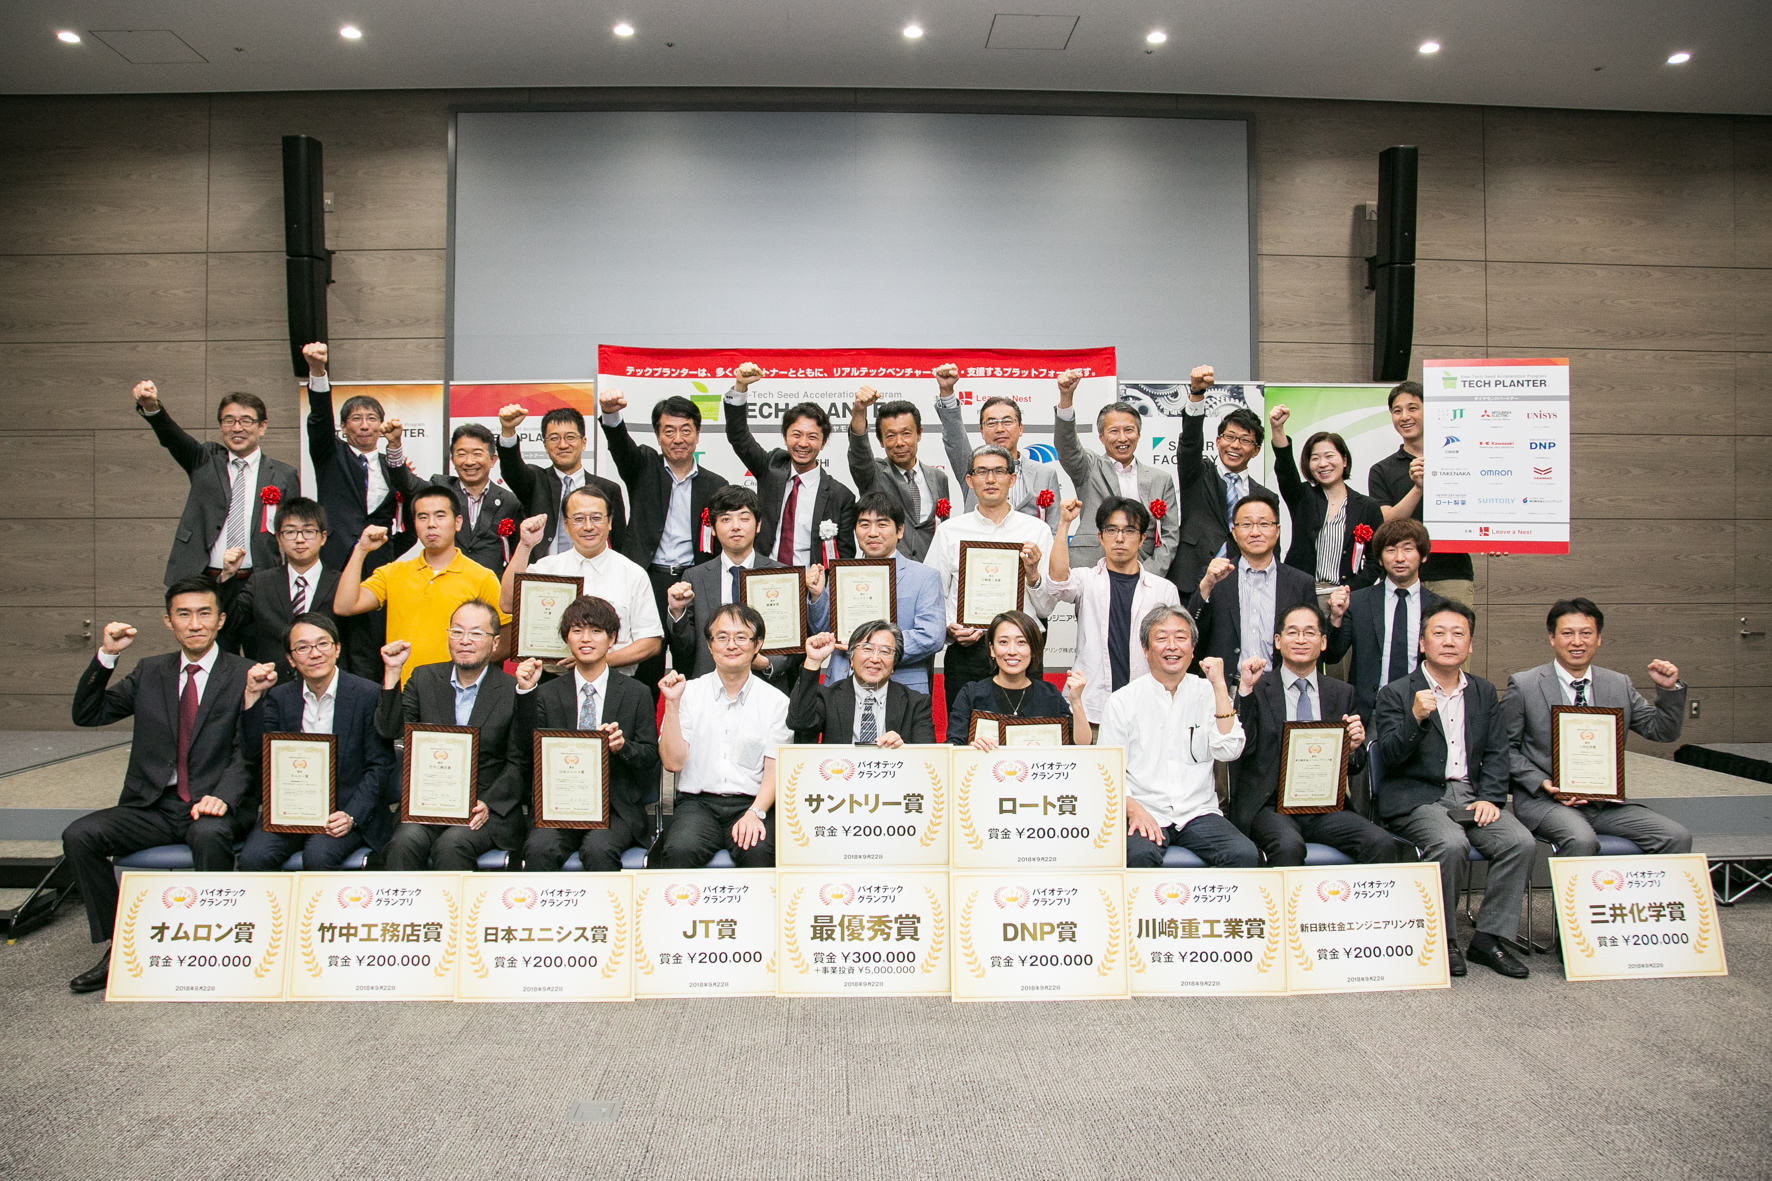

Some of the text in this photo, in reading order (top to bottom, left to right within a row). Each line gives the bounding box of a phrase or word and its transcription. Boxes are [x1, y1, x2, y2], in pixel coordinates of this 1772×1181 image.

[881, 392, 902, 400] gram
[746, 402, 789, 418] ECH
[1450, 409, 1465, 421] JT
[858, 761, 904, 769] バイオテック
[1031, 762, 1077, 770] バイオテック
[858, 770, 896, 779] グランプリ
[1031, 772, 1069, 780] グランプリ
[805, 793, 924, 814] サントリー賞
[999, 795, 1078, 816] ロート賞
[815, 826, 838, 837] 賞金
[988, 828, 1012, 840] 賞金
[858, 885, 904, 894] バイオテック
[1193, 885, 1239, 893] バイオテック
[1353, 880, 1396, 889] バイオテック
[1628, 880, 1661, 888] グランプリ
[200, 889, 246, 897] バイオテック
[376, 888, 422, 897] バイオテック
[540, 889, 587, 897] バイオテック
[703, 886, 749, 894] バイオテック
[1032, 888, 1078, 896] バイオテック
[1354, 890, 1389, 899] グランプリ
[199, 899, 237, 907] グランプリ
[375, 898, 413, 907] グランプリ
[540, 899, 578, 907] グランプリ
[703, 895, 742, 903] グランプリ
[858, 895, 896, 904] グランプリ
[1033, 898, 1071, 906] グランプリ
[1193, 895, 1231, 903] グランプリ
[1589, 902, 1686, 924] 三井化学賞
[683, 919, 737, 940] JT賞
[810, 914, 921, 942] 最優秀賞
[1137, 918, 1265, 939] 川崎重工業賞
[1300, 919, 1425, 933] 新日鉄住金エンジニアリング賞
[150, 922, 255, 943] オムロン賞
[318, 922, 443, 943] 竹中工務店賞
[484, 926, 609, 943] 日本ユニシス賞
[1003, 922, 1077, 942] DNP賞
[1597, 936, 1619, 947] 賞金
[660, 953, 683, 965] 賞金
[813, 952, 837, 964] 賞金
[1151, 951, 1174, 963] 賞金
[1317, 948, 1339, 960] 賞金
[149, 955, 173, 967] 賞金
[328, 955, 352, 967] 賞金
[494, 956, 518, 968] 賞金
[990, 956, 1014, 968] 賞金
[858, 966, 915, 975] ¥5,000,000
